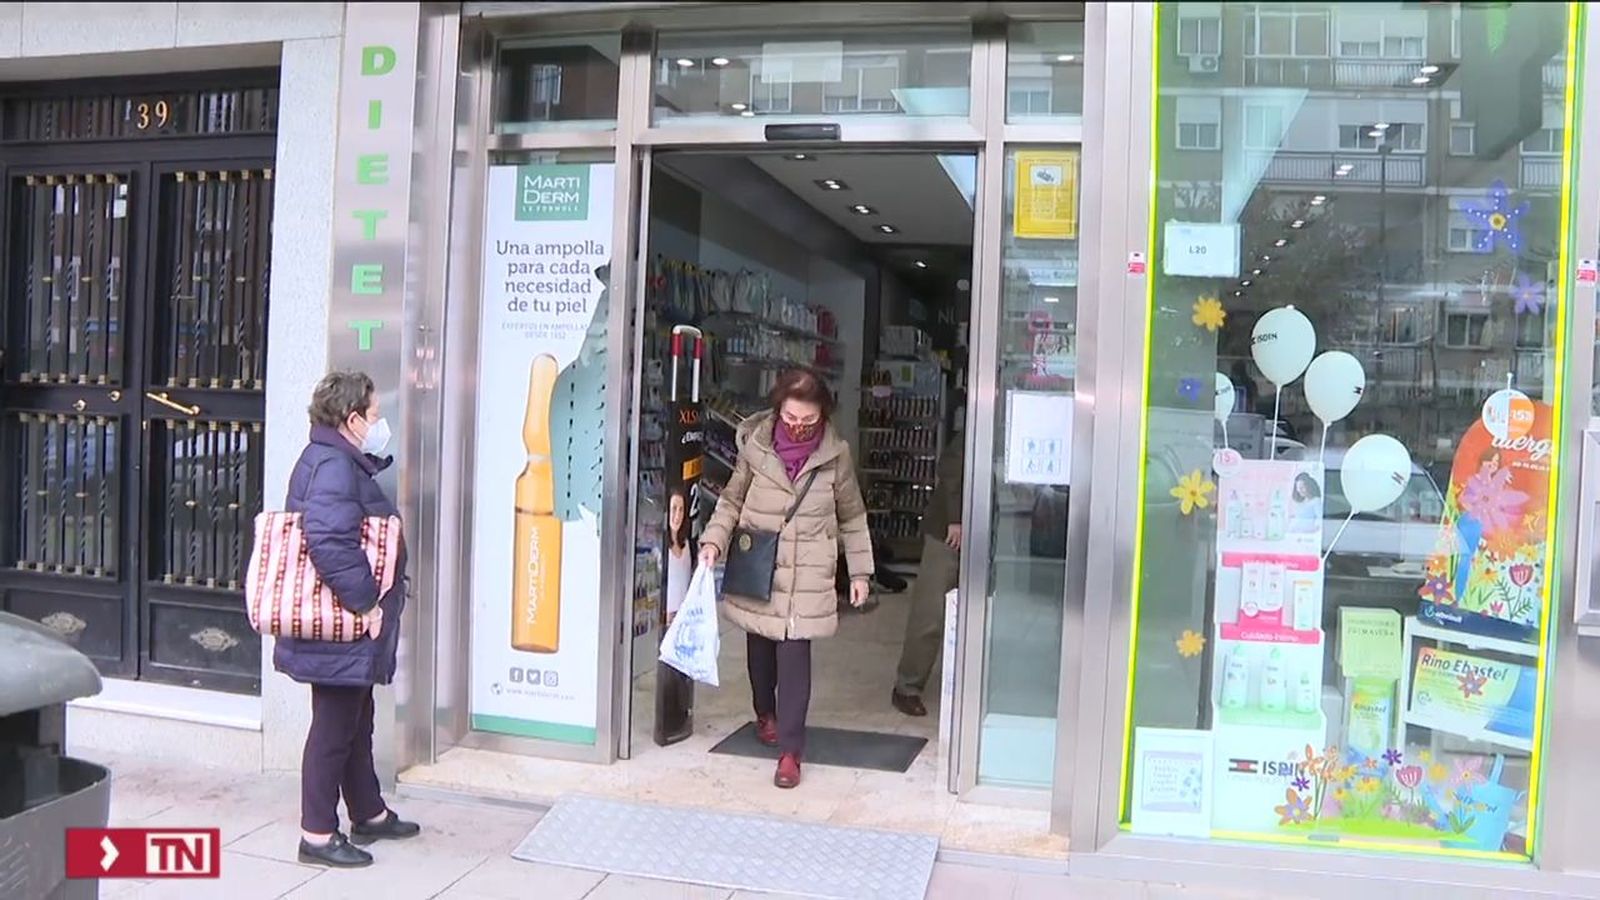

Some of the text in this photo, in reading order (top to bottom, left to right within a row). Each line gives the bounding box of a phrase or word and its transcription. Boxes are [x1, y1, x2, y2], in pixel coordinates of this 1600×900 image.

[137, 100, 168, 129] 39
[496, 240, 605, 259] Una ampolla
[508, 260, 590, 277] para cada
[505, 279, 592, 294] necesidad
[507, 297, 587, 316] de tu piel
[1421, 653, 1451, 671] Rino
[1453, 659, 1509, 681] Ebastel
